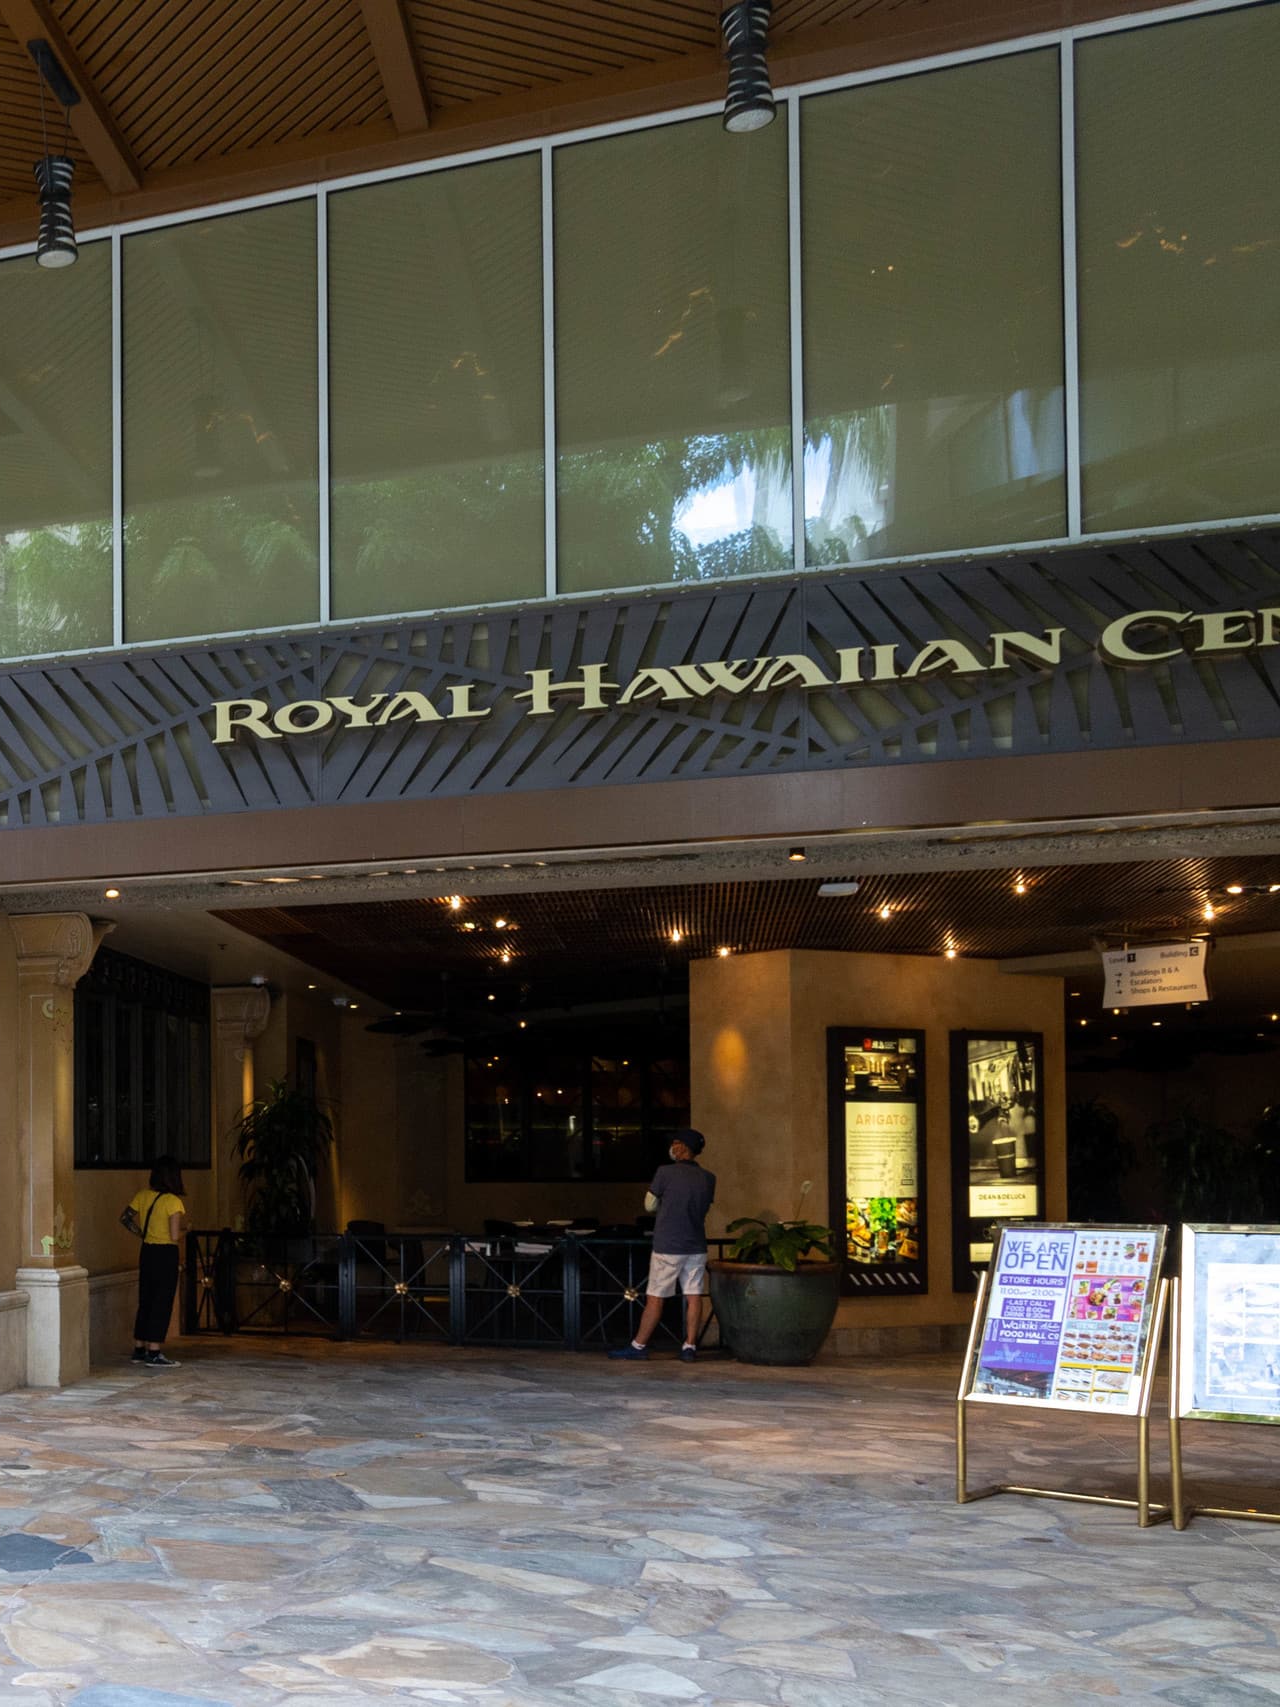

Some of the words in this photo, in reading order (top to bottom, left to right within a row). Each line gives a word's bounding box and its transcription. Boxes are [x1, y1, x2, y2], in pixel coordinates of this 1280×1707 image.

[211, 684, 492, 744] ROYAL
[513, 627, 1066, 716] HAWAIIAN
[1160, 950, 1188, 960] Building
[1130, 967, 1160, 977] Buildings
[1130, 977, 1163, 986] Escalators
[1130, 986, 1151, 995] Shops
[1158, 983, 1198, 992] Restaurants
[855, 1114, 908, 1126] ARIGATO
[1007, 1240, 1032, 1253] WE
[1036, 1241, 1071, 1255] ARE
[1004, 1252, 1068, 1271] OPEN
[1002, 1275, 1031, 1285] STORE
[1033, 1277, 1065, 1286] HOURS
[1001, 1320, 1038, 1330] Waikiki
[999, 1329, 1025, 1338] FOOD
